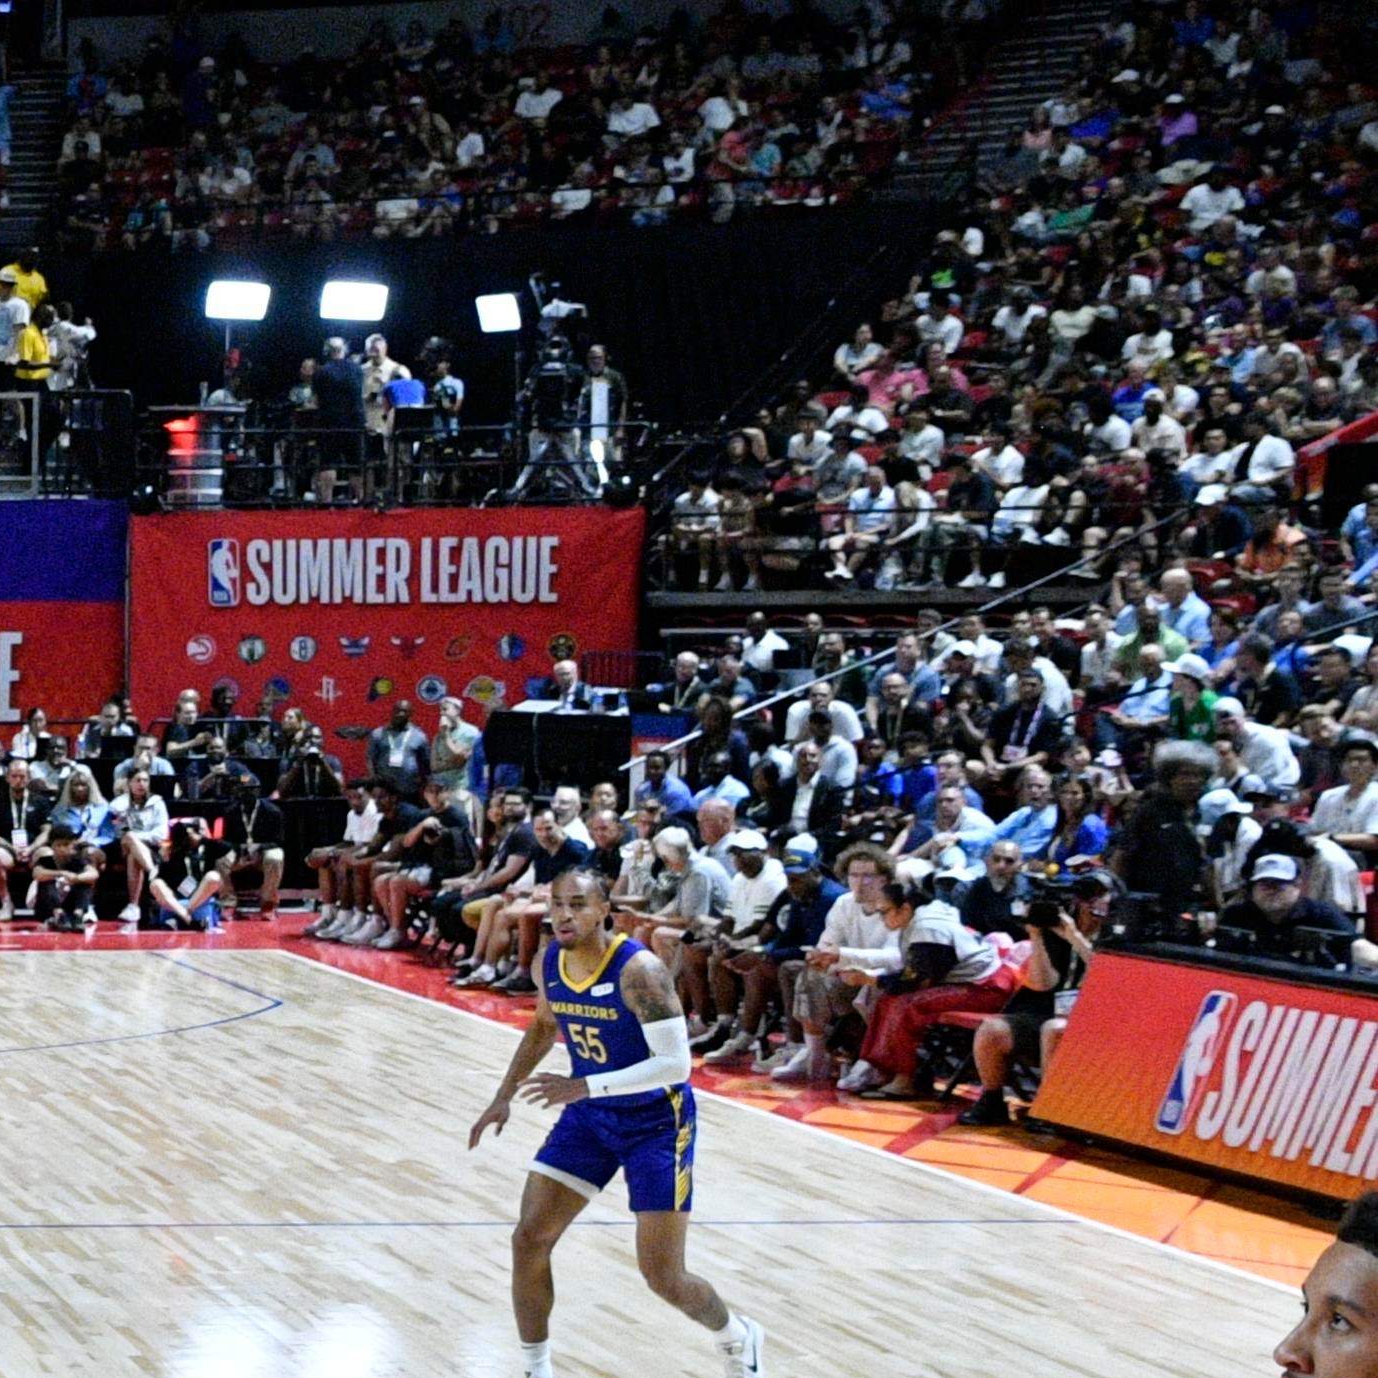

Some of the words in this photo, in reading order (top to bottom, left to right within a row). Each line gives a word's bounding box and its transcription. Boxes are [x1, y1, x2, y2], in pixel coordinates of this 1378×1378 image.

[245, 537, 411, 606] SUMMER
[419, 535, 560, 604] LEAGUE
[549, 1000, 619, 1021] WARRIORS
[567, 1022, 609, 1065] 55
